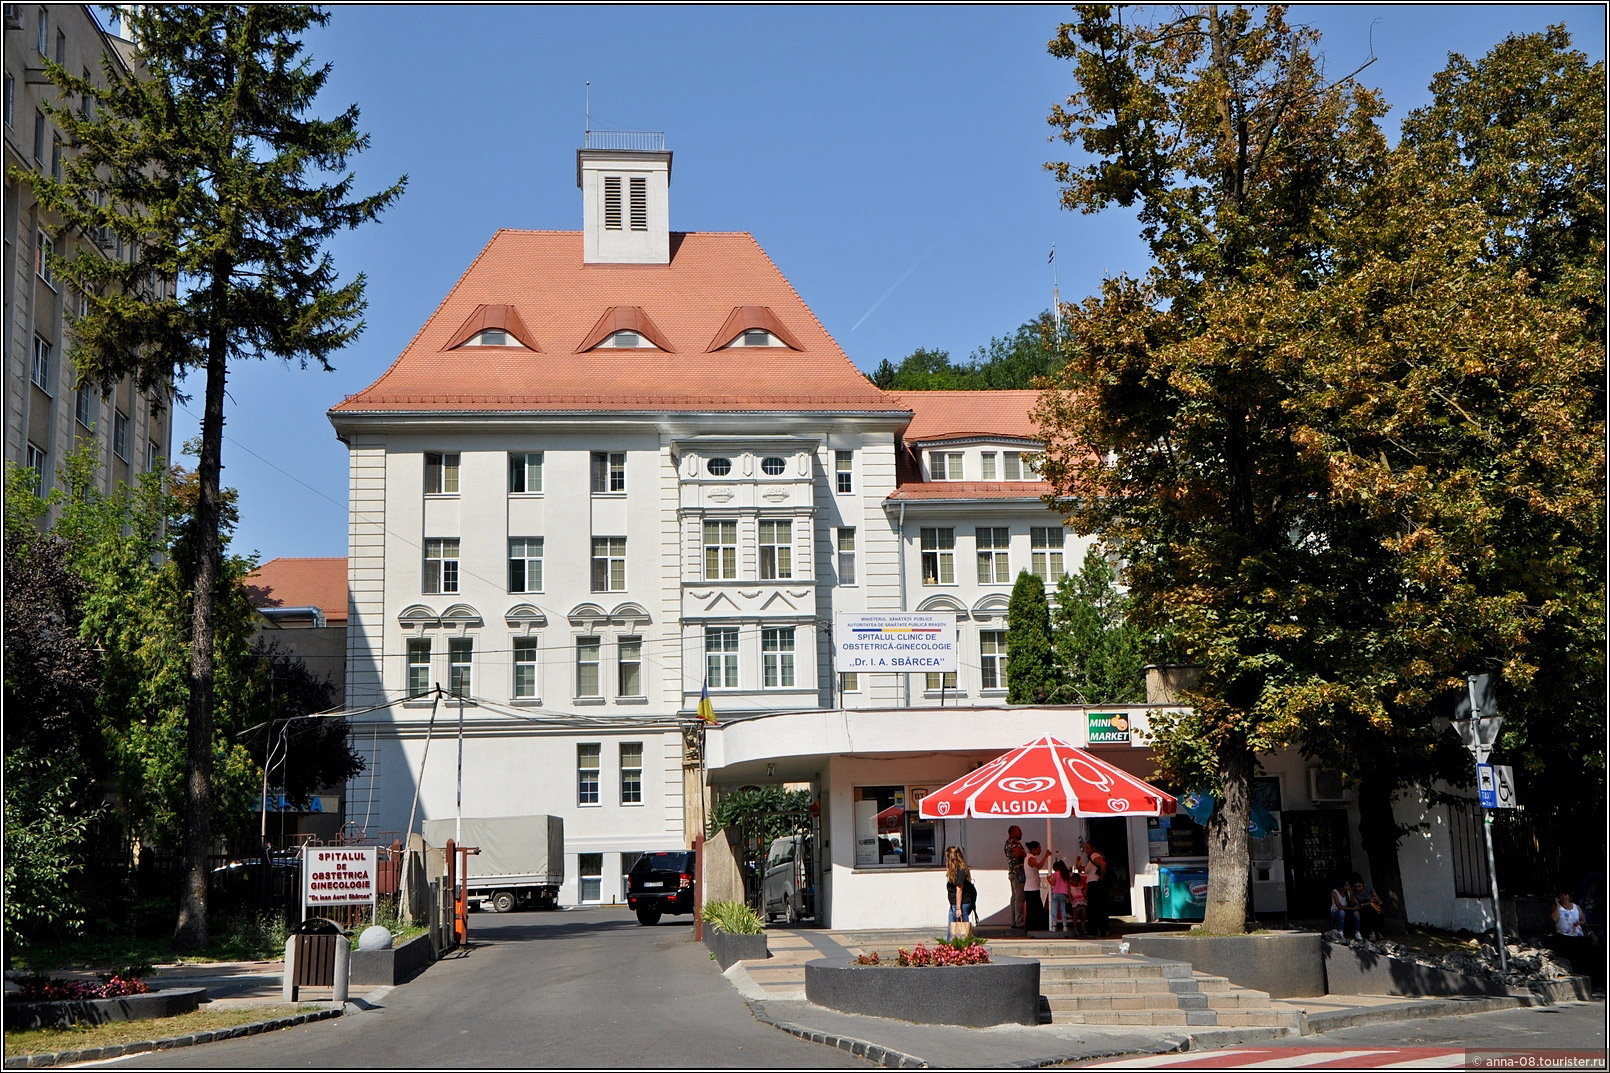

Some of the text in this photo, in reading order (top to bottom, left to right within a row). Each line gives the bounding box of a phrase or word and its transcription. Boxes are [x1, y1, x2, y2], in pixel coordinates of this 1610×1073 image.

[842, 642, 952, 650] OBSTETRICĂ-GINECOLOGIE
[870, 658, 876, 666] I.
[878, 658, 889, 666] A.
[1089, 718, 1111, 728] MINI
[1090, 732, 1129, 741] MARKET
[990, 800, 1049, 813] ALGIDA
[318, 852, 366, 861] SPITALUL
[312, 870, 369, 880] OBSTETRICĂ
[310, 881, 371, 890] GINECOLOGIE
